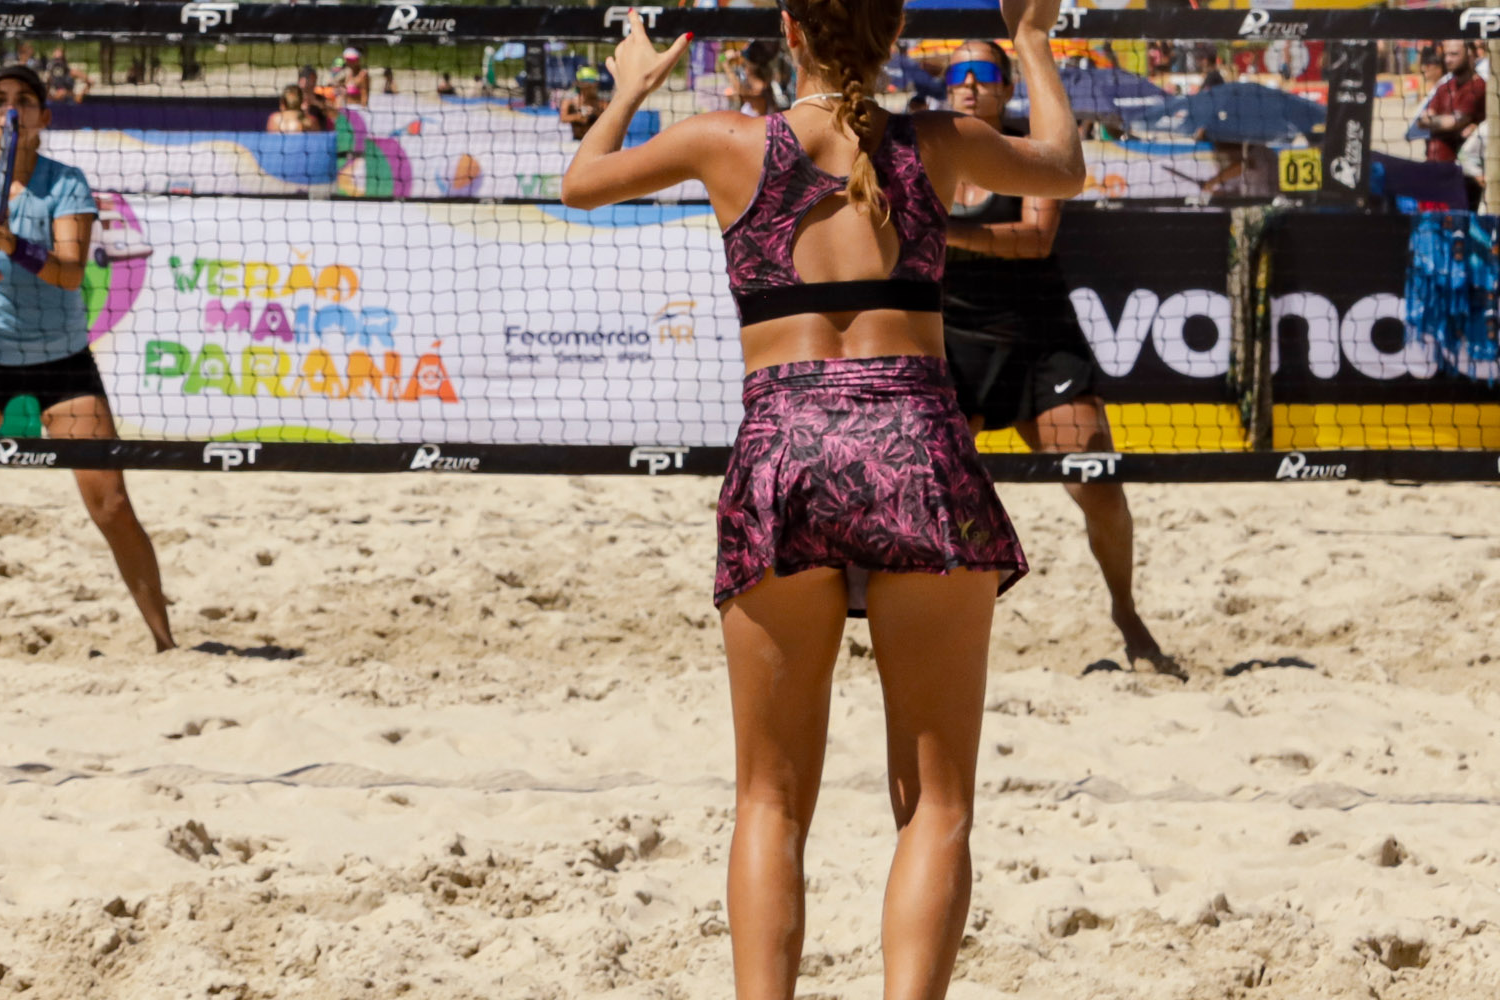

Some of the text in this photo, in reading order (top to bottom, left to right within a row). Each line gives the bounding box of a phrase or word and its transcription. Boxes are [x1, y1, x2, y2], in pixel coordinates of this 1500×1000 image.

[1285, 159, 1316, 185] 03
[168, 247, 360, 303] VERÃO
[204, 299, 398, 348] MAIOR
[505, 323, 651, 346] Fecomércio
[143, 339, 460, 404] PARANÁ
